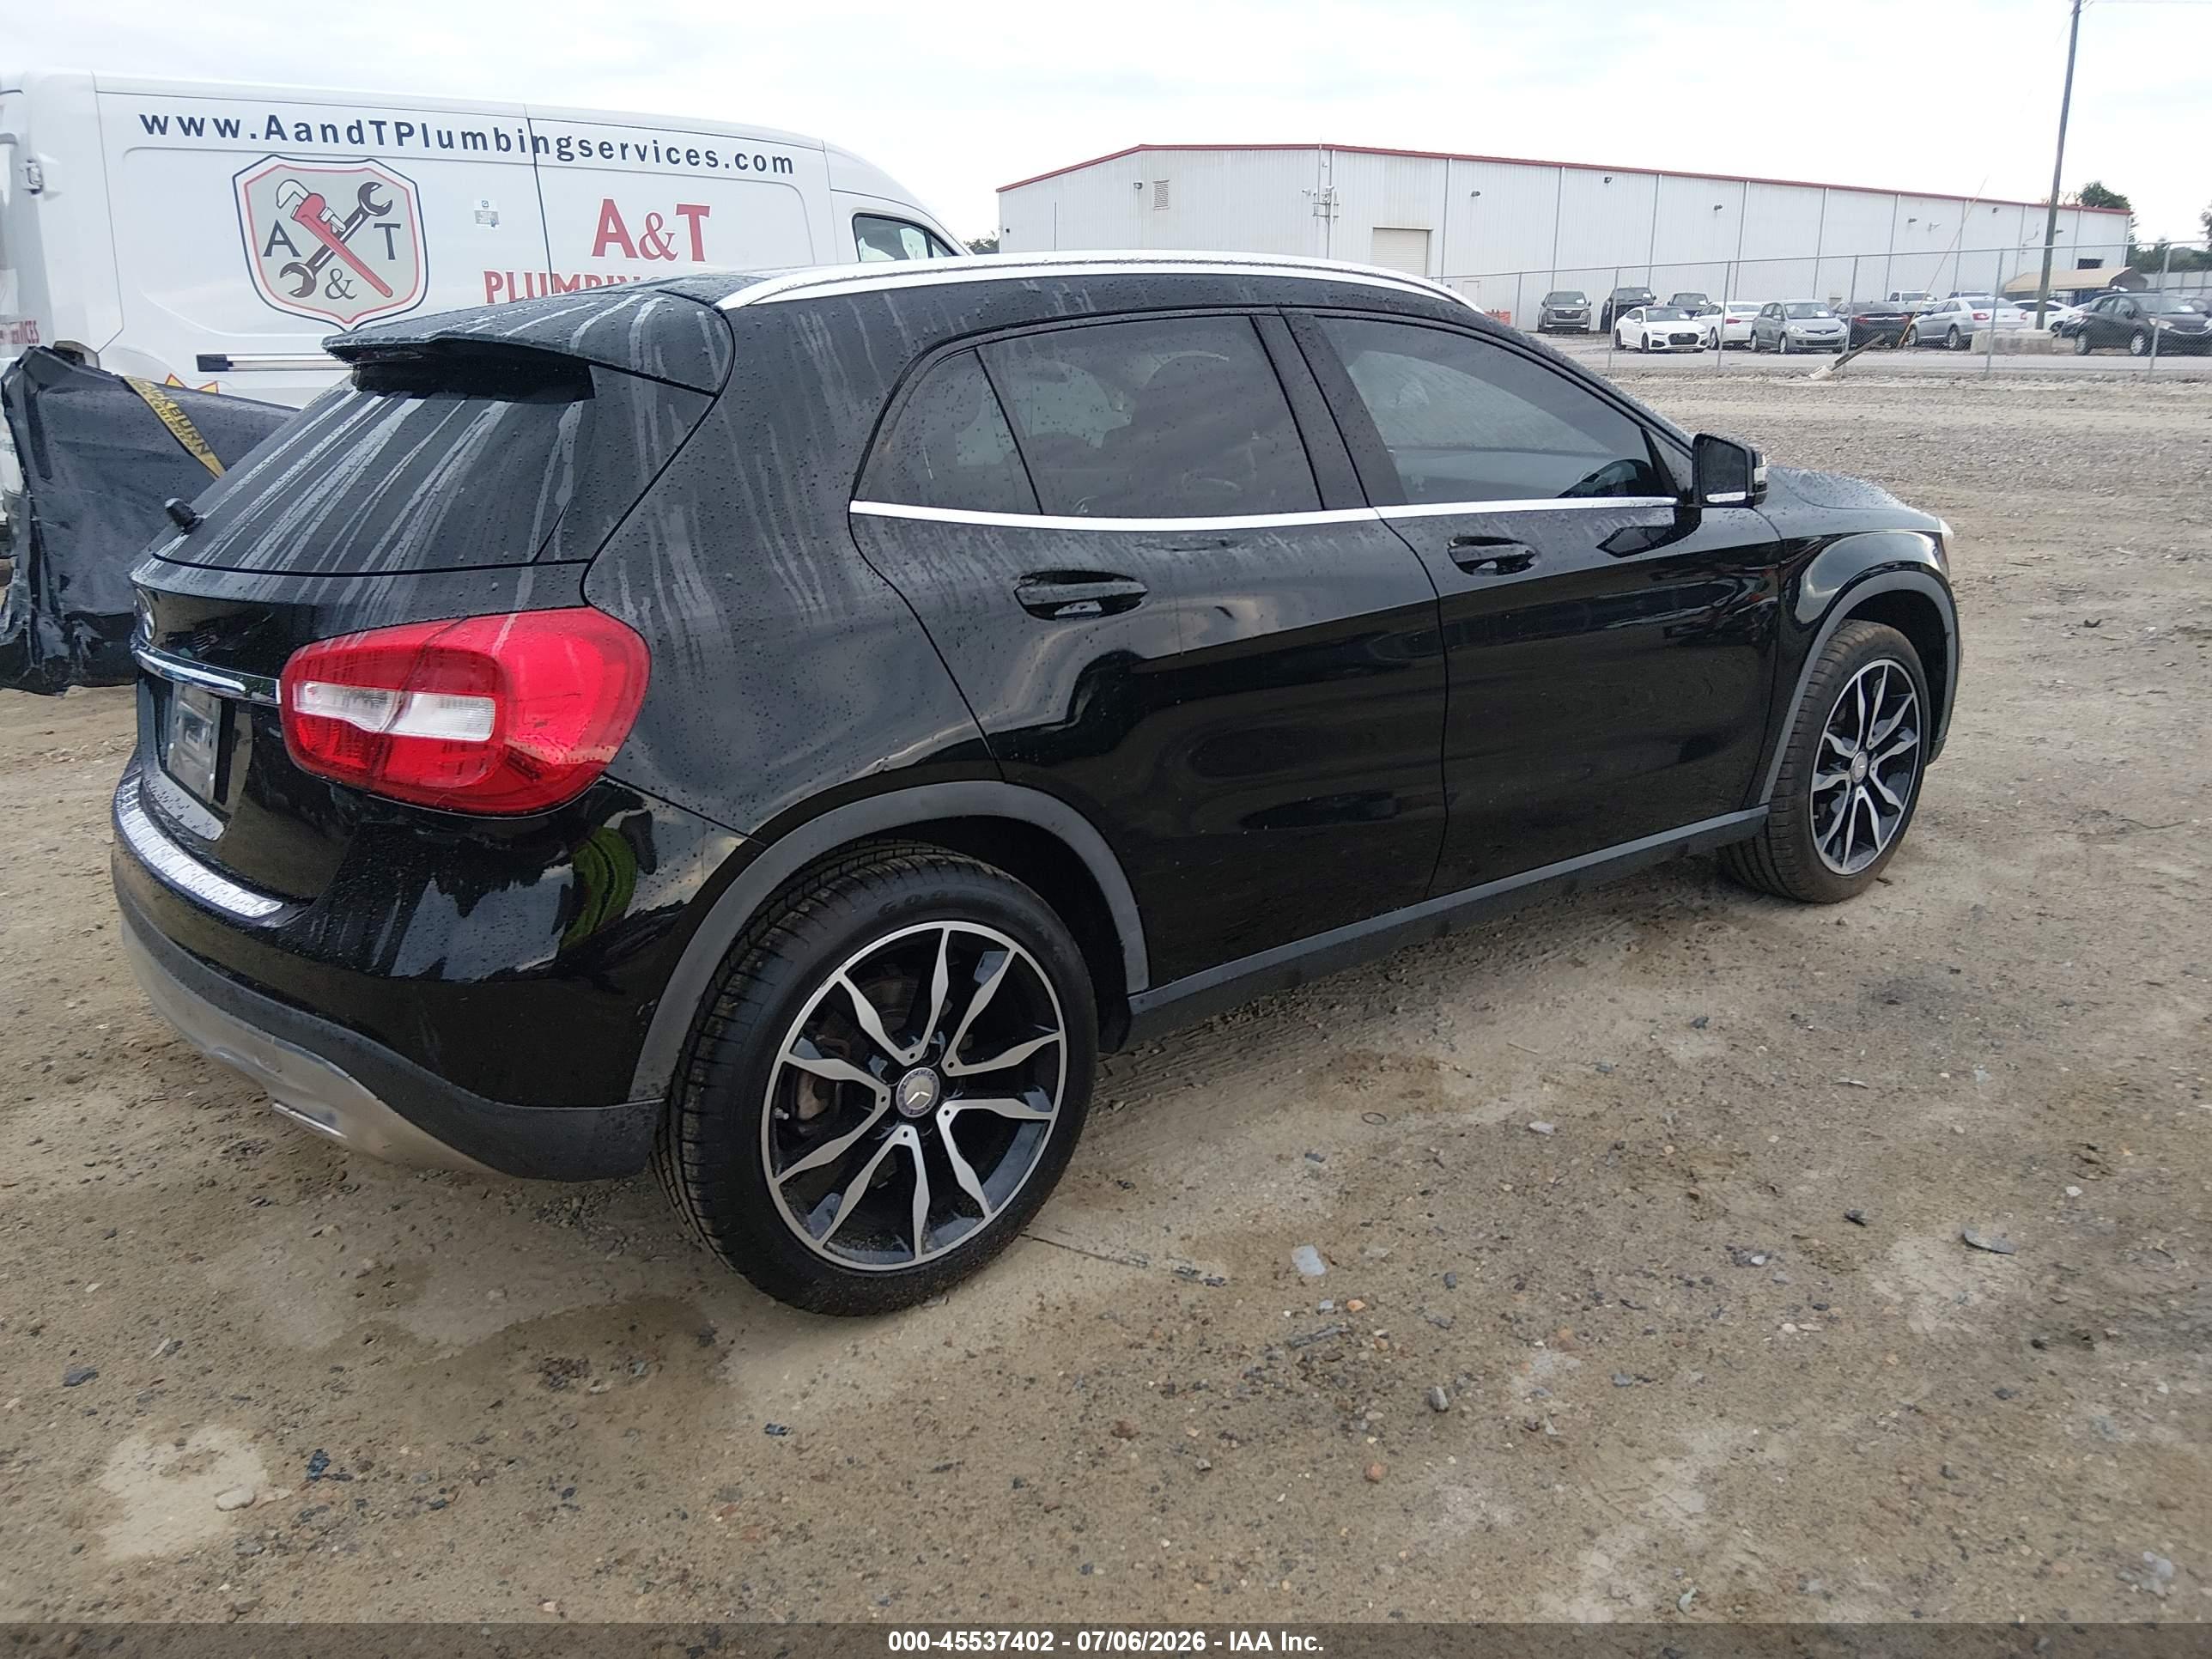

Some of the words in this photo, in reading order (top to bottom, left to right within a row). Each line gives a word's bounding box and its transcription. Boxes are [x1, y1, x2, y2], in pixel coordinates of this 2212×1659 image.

[138, 113, 794, 174] www.AandTPlumbingservices.com
[263, 219, 301, 258] A
[373, 222, 402, 260] T
[591, 198, 711, 262] A&T
[325, 268, 357, 300] &
[483, 270, 661, 304] PLUM
